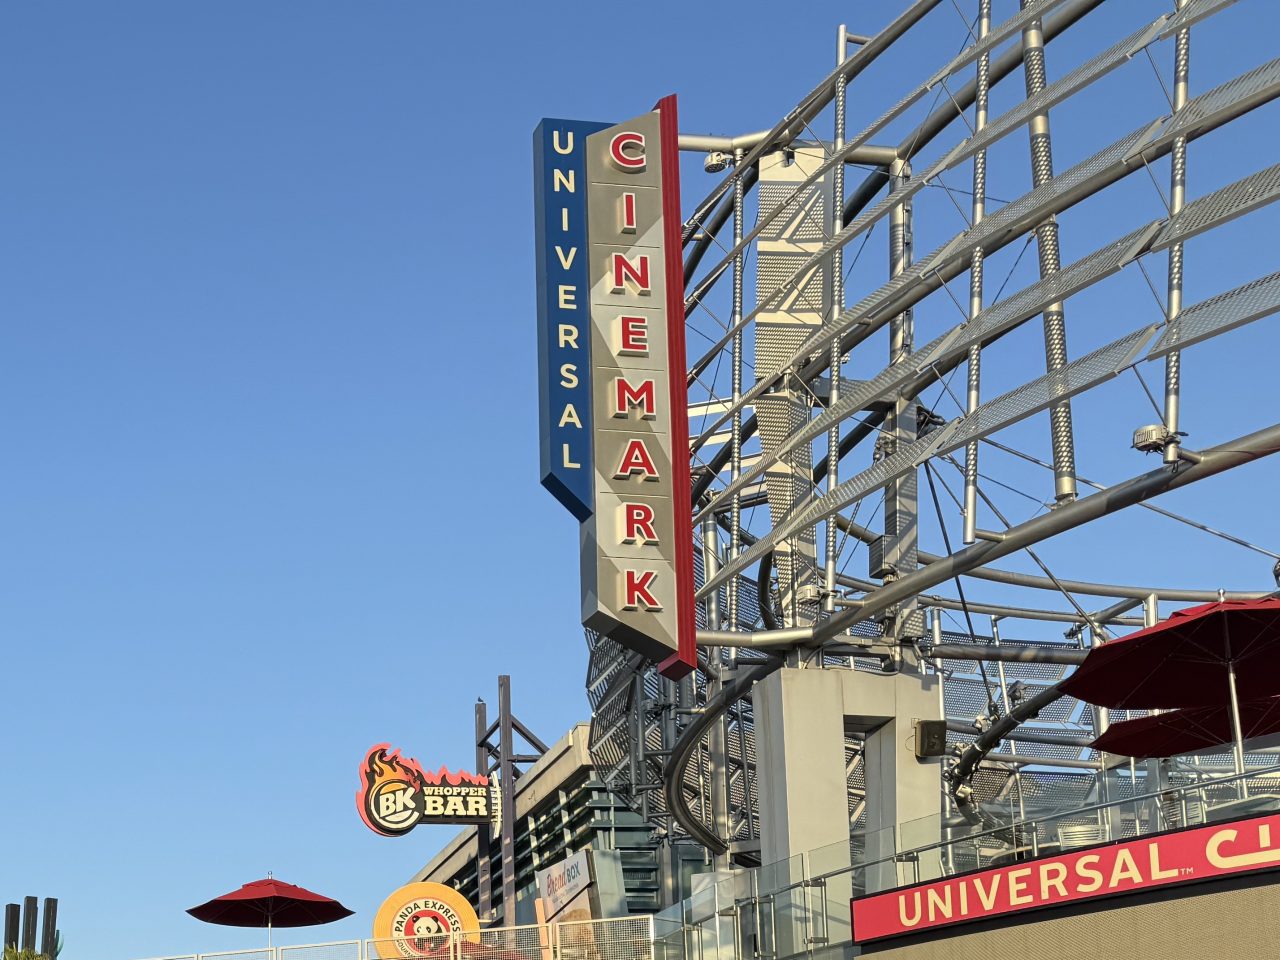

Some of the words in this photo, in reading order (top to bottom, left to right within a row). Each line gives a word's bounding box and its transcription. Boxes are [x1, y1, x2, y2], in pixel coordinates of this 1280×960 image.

[552, 130, 581, 470] UNIVERSAL
[609, 131, 662, 611] CINEMARK
[380, 788, 416, 818] BK
[423, 786, 487, 796] WHOPPER
[424, 796, 487, 816] BAR
[567, 861, 580, 882] BOX
[899, 843, 1179, 927] UNIVERSAL
[395, 902, 420, 932] PANDA
[424, 900, 461, 932] EXPRESS
